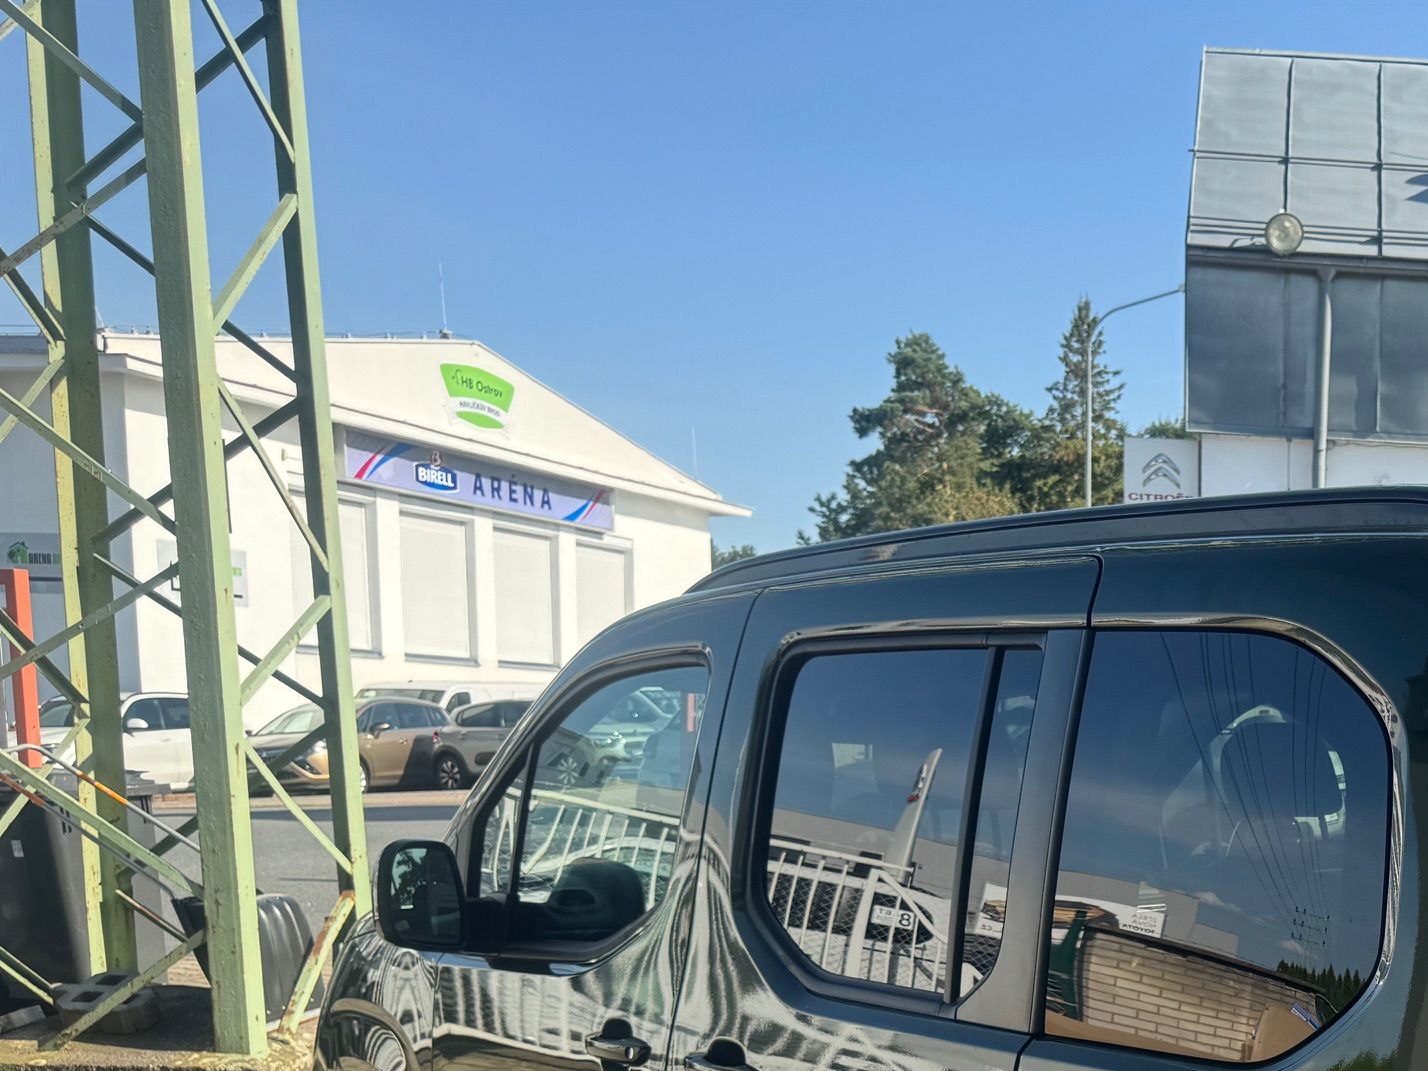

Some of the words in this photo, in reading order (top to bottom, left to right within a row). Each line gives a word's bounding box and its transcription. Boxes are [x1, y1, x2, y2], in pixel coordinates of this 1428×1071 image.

[460, 376, 474, 389] HB
[476, 380, 504, 398] Ostrov
[417, 466, 455, 487] BIRELL
[473, 473, 552, 510] ARÉNA
